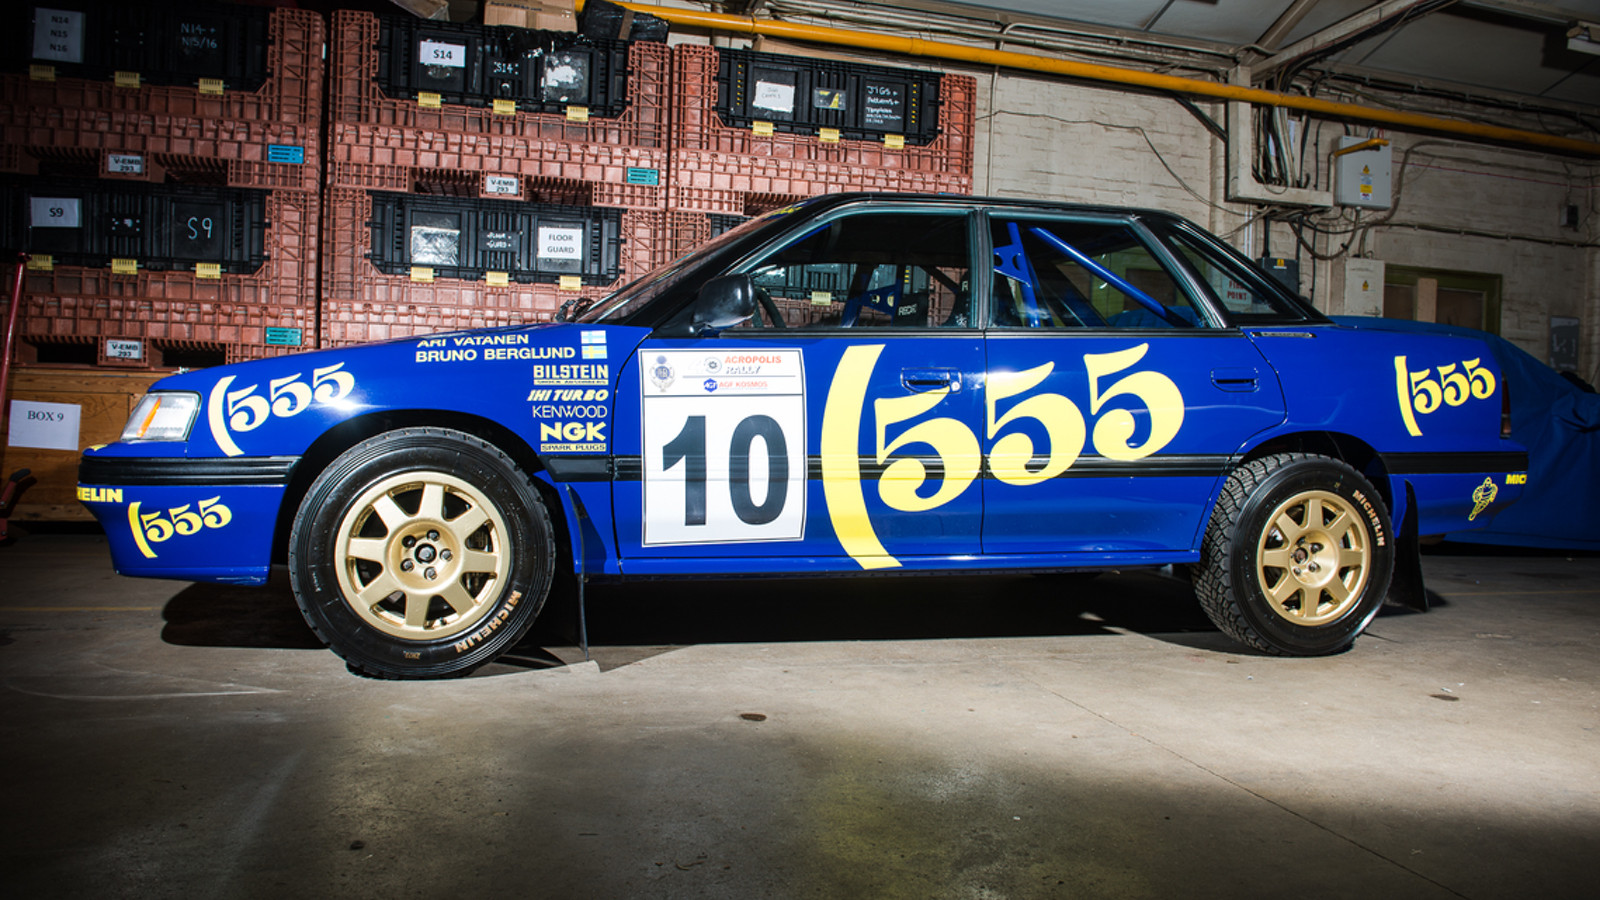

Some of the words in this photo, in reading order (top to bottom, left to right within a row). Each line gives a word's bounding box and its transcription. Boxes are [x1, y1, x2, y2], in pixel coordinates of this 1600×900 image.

[51, 15, 69, 25] N14
[50, 29, 68, 38] N15
[50, 43, 68, 53] N16
[433, 48, 453, 60] S14
[113, 158, 141, 166] V-EMB
[490, 178, 515, 187] V-EMB
[495, 185, 510, 193] 293
[49, 207, 64, 218] S9
[187, 216, 214, 240] S9
[548, 234, 574, 242] FLOOR
[547, 246, 575, 254] GUARD
[1226, 290, 1247, 301] POINT
[416, 338, 447, 348] ARI
[453, 333, 529, 347] VATANEN
[111, 343, 139, 352] V-EMB
[117, 350, 132, 358] 293
[415, 348, 478, 363] BRUNO
[484, 346, 576, 361] BERGLUND
[724, 355, 782, 364] ACROPOLIS
[533, 364, 609, 379] BILSTEIN
[726, 366, 761, 375] RALLY
[526, 389, 551, 402] IHI
[552, 389, 609, 402] TURBO
[27, 410, 55, 422] BOX
[57, 412, 64, 422] 9
[532, 404, 608, 418] KENWOOD
[540, 421, 607, 442] NGK
[541, 443, 573, 452] SPARK
[575, 443, 606, 452] PLUGS
[662, 414, 789, 527] 10
[1352, 489, 1386, 547] MICHELIN
[454, 589, 523, 653] MICHELIN
